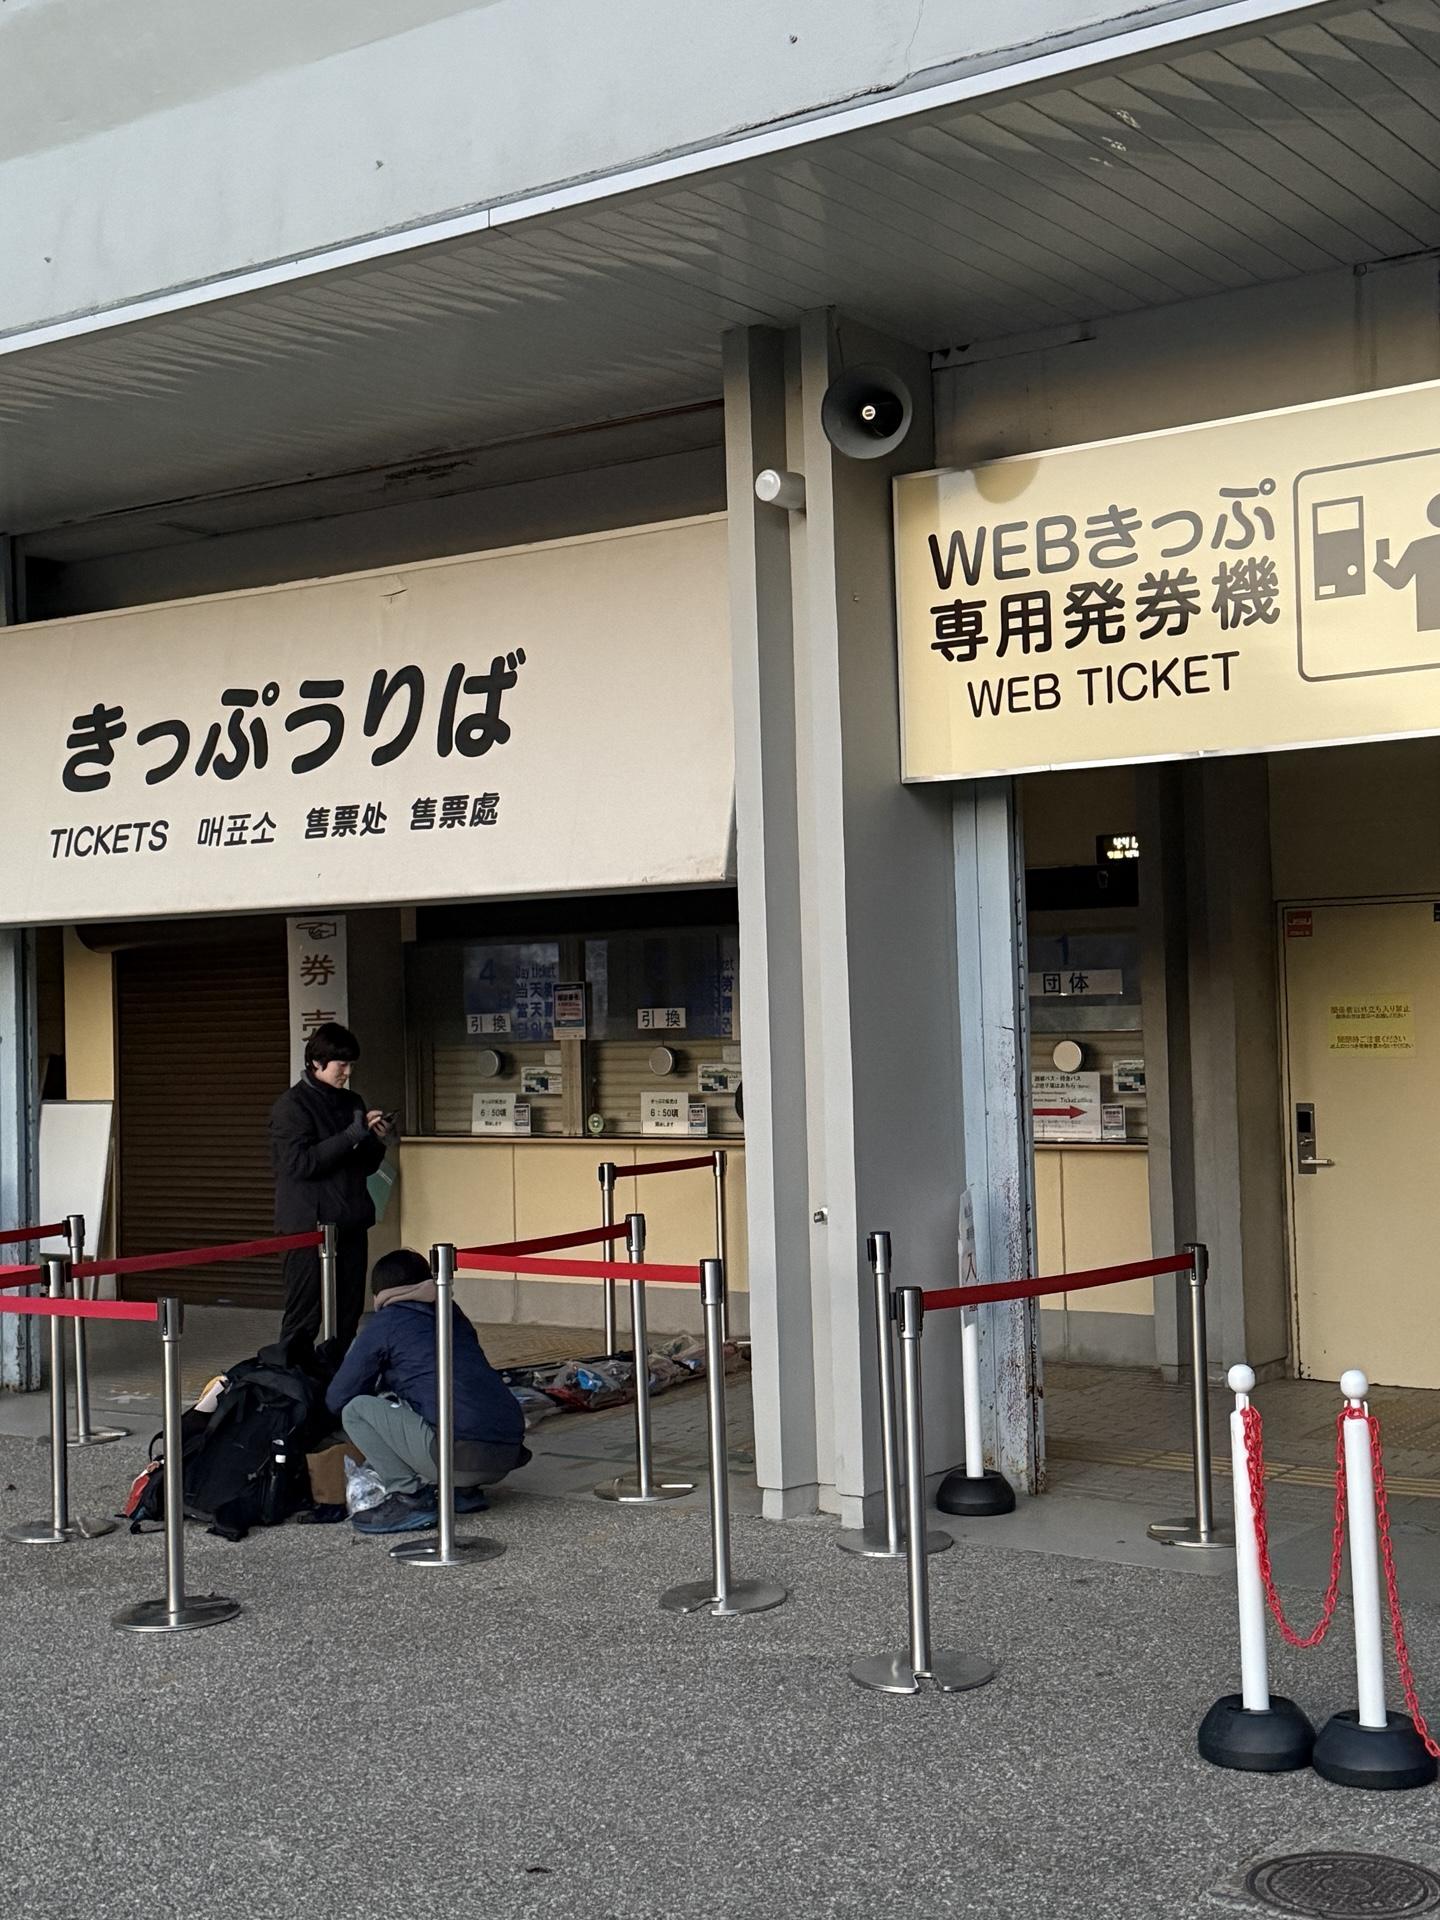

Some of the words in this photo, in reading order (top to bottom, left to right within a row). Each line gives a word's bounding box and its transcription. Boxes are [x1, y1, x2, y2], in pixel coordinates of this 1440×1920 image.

[928, 478, 1277, 590] WEBきっぷ
[929, 555, 1281, 662] 専用発券機
[968, 673, 1062, 718] WEB
[1077, 650, 1240, 706] TICKET
[63, 647, 527, 793] きっぷうりば
[51, 819, 169, 858] TICKETS
[197, 811, 277, 847] 매표소
[304, 801, 388, 840] 售票处
[410, 793, 500, 831] 售票處
[1043, 972, 1089, 994] 団体
[471, 1015, 506, 1033] 引換
[642, 1009, 681, 1027] 引換
